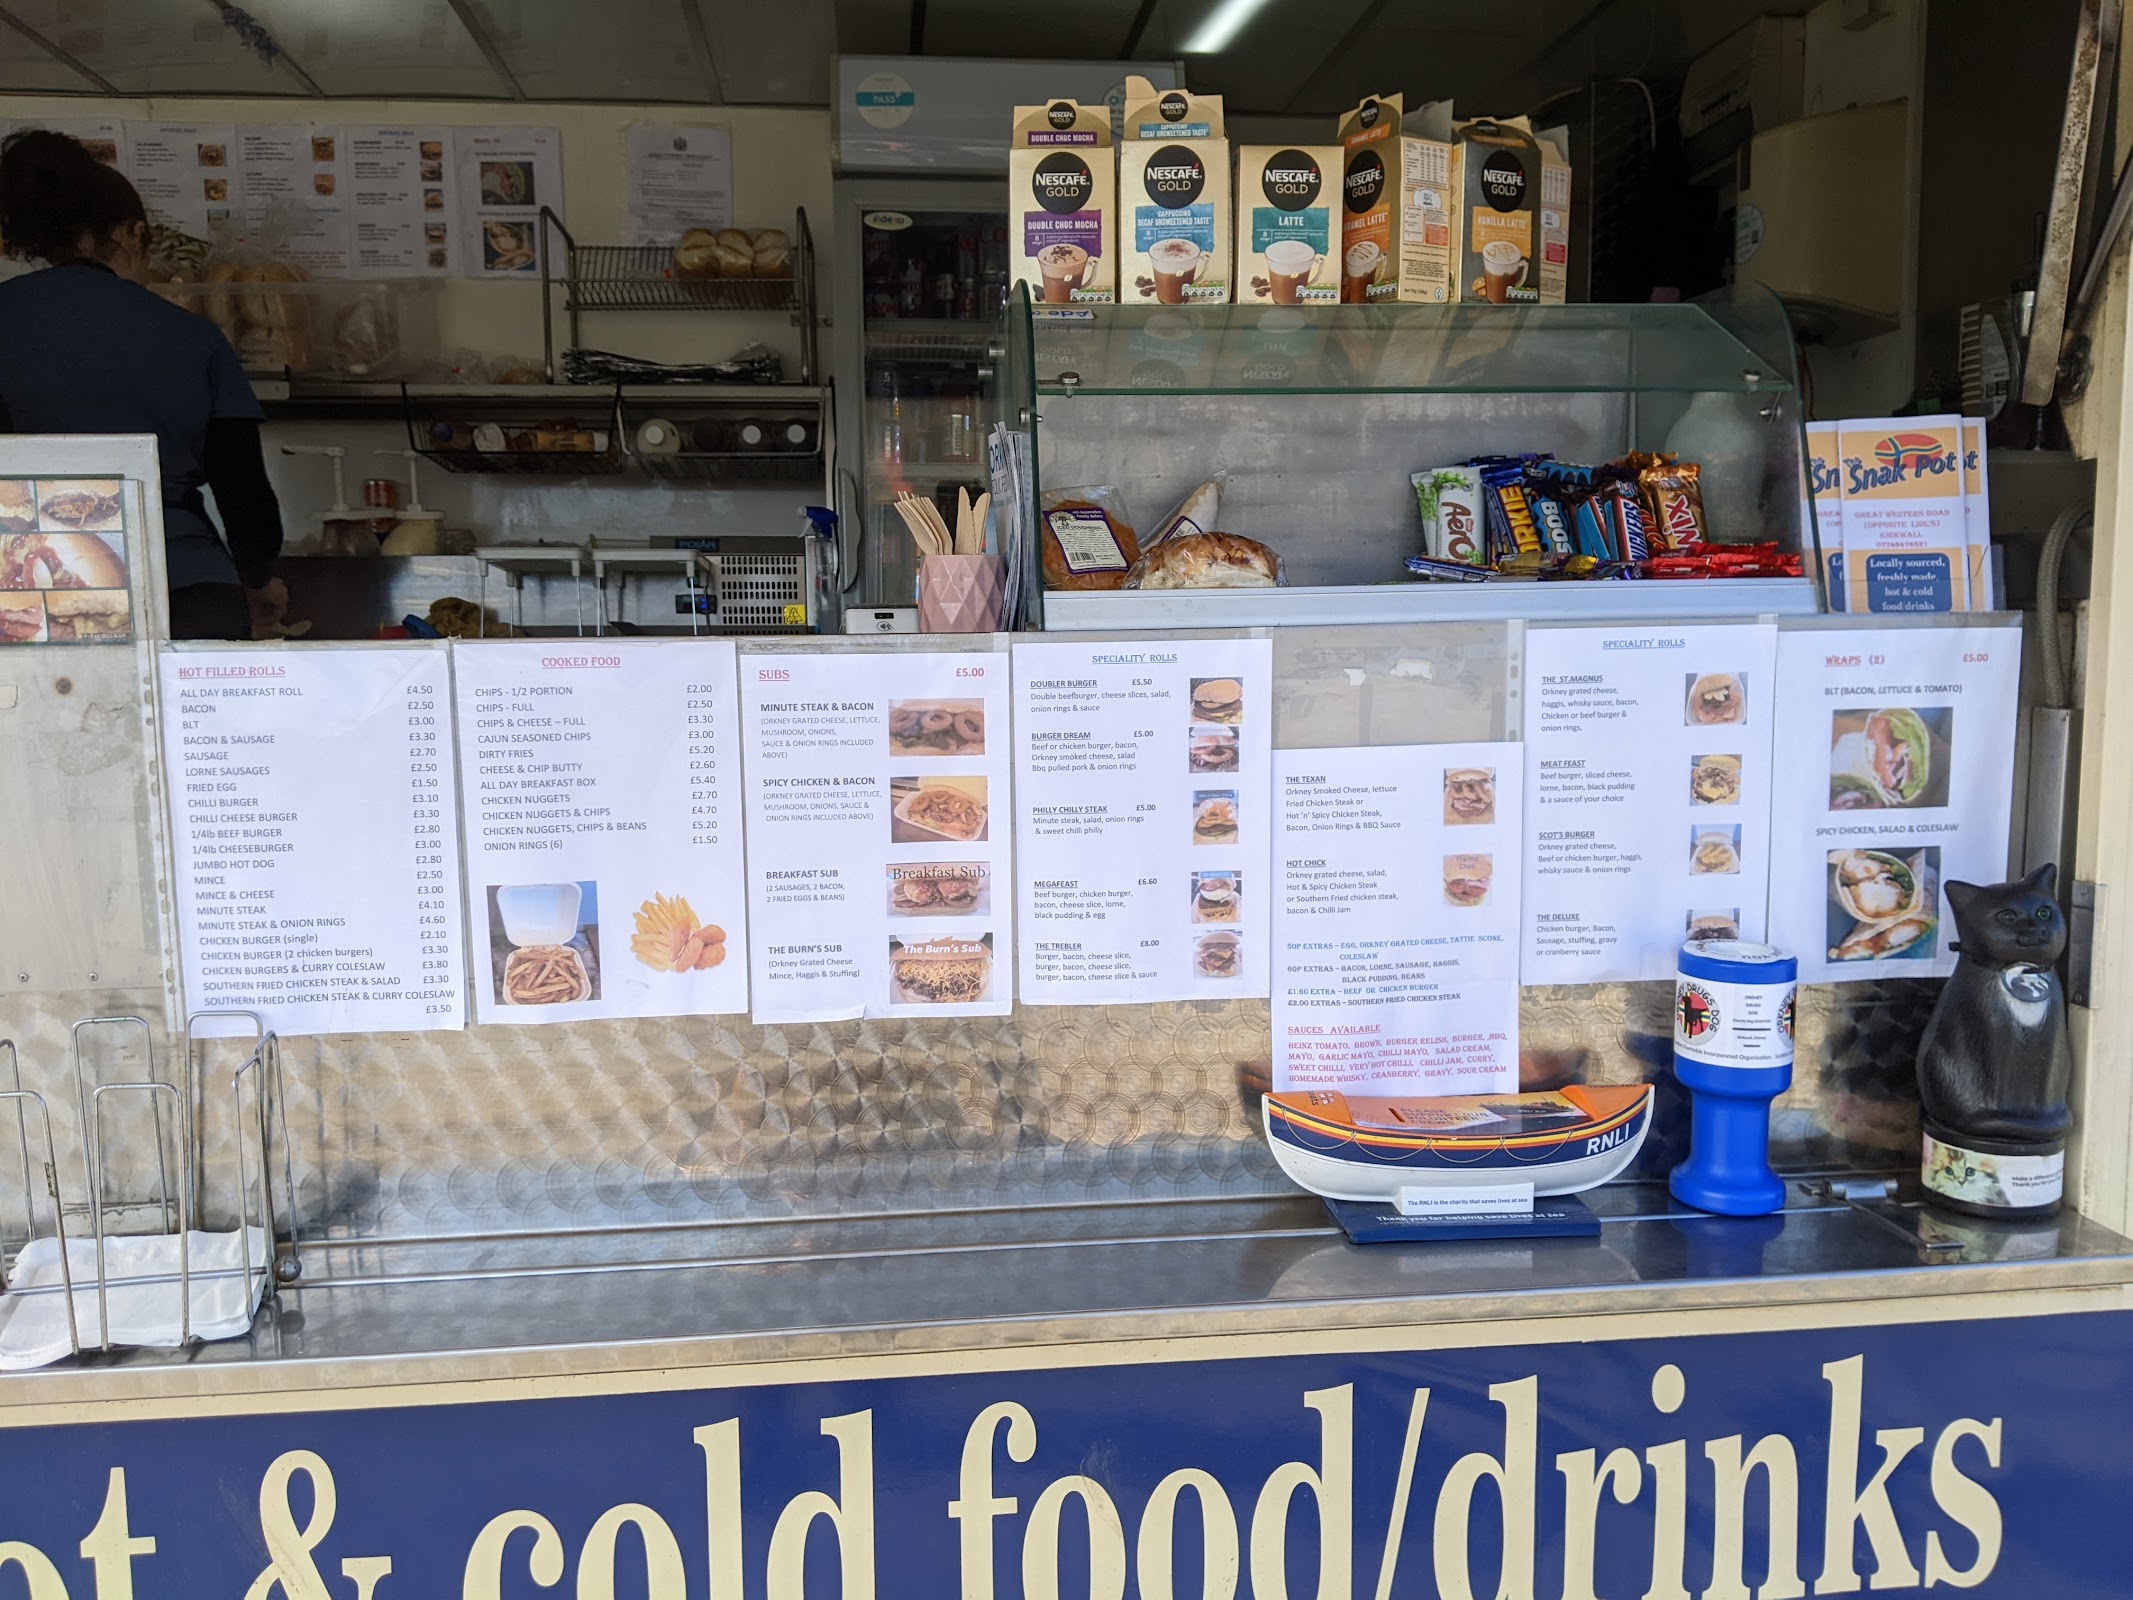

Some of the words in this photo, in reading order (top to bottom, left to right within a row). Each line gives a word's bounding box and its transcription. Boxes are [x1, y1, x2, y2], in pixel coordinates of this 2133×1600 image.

[873, 95, 896, 104] PASS
[1031, 134, 1054, 142] DOUBLE
[1055, 134, 1071, 142] CHOC
[1147, 163, 1203, 180] NESCAFÉ
[1265, 167, 1320, 183] NESCAFÉ
[1346, 164, 1383, 188] NESCAFÉ
[1035, 169, 1091, 186] NESCAFÉ
[1483, 169, 1525, 187] NESCAFÉ
[1045, 186, 1079, 197] GOLD
[1156, 181, 1191, 191] GOLD
[1275, 184, 1308, 194] GOLD
[1351, 184, 1375, 197] GOLD
[1491, 185, 1518, 196] GOLD
[1157, 209, 1191, 217] CAPPUCCINO
[1027, 220, 1053, 230] DOUBLE
[1054, 220, 1073, 229] CHOC
[1074, 220, 1098, 229] MOCHA
[1278, 216, 1304, 226] LATTE
[1344, 219, 1366, 230] ARAMEL
[1476, 215, 1505, 226] VANILLA
[1848, 457, 1906, 495] Snak
[1914, 452, 1957, 478] Pot
[1500, 486, 1541, 553] ORKIE
[1441, 501, 1476, 561] Aero
[1541, 501, 1573, 553] BOOS
[1624, 501, 1648, 561] NICKERS
[1868, 555, 1903, 569] Locally
[1905, 554, 1947, 567] sourced,
[1877, 572, 1908, 584] freshly
[1884, 586, 1900, 596] hot
[1901, 587, 1911, 596] &
[1912, 586, 1933, 596] cold
[1881, 601, 1936, 613] food/drinks
[1603, 640, 1654, 648] SPECIALITY
[1658, 639, 1686, 647] ROLLS
[541, 657, 589, 667] COOKED
[591, 656, 621, 667] FOOD
[1092, 655, 1146, 664] SPECIALITY
[1149, 653, 1178, 663] ROLLS
[1825, 655, 1861, 666] WRAPS
[1868, 654, 1885, 665] (2)
[1962, 653, 1988, 662] £5.00
[179, 667, 203, 678] HOT
[206, 667, 246, 677] FILLED
[249, 666, 286, 676] ROLLS
[758, 669, 790, 681] SUBS
[956, 667, 984, 677] £5.00
[180, 689, 198, 698] ALL
[199, 688, 219, 697] DAY
[222, 687, 276, 697] BREAKFAST
[279, 687, 303, 696] ROLL
[406, 685, 433, 694] £4.50
[1824, 687, 1839, 695] BLT
[1840, 686, 1876, 696] (BACON,
[1878, 685, 1912, 694] LETTUCE
[1914, 685, 1922, 693] &
[1923, 684, 1963, 693] TOMATO)
[476, 703, 504, 712] CHIPS
[511, 703, 534, 711] FULL
[687, 699, 712, 708] £2.50
[760, 703, 798, 711] MINUTE
[800, 703, 829, 711] STEAK
[831, 702, 839, 711] &
[841, 702, 874, 711] BACON
[477, 734, 508, 743] CAJUN
[511, 733, 562, 742] SEASONED
[564, 732, 591, 741] CHIPS
[688, 730, 714, 739] £3.00
[1063, 732, 1091, 740] DREAM
[478, 750, 506, 758] DIRTY
[508, 749, 534, 758] FRIES
[689, 745, 714, 754] £5.20
[1541, 760, 1561, 768] MEAT
[189, 814, 218, 823] CHILLI
[220, 813, 256, 822] CHEESE
[258, 812, 298, 822] BURGER
[413, 809, 439, 818] £3.30
[1304, 859, 1326, 867] CHICK
[892, 867, 956, 880] Breakfast
[960, 866, 986, 879] Sub
[1034, 880, 1078, 889] MEGAFEAST
[419, 915, 445, 924] £4.60
[1552, 913, 1580, 921] DELUXE
[198, 921, 236, 930] MINUTE
[238, 921, 267, 929] STEAK
[269, 920, 278, 929] &
[280, 918, 314, 928] ONION
[316, 917, 345, 926] RINGS
[199, 936, 239, 945] CHICKEN
[242, 935, 281, 945] BURGER
[283, 933, 318, 944] (single)
[420, 930, 446, 939] £2.10
[903, 945, 920, 953] The
[925, 944, 958, 953] Burn's
[961, 944, 982, 952] Sub
[1687, 982, 1715, 1006] DRUGS
[1709, 1009, 1720, 1033] DOG
[1288, 1026, 1324, 1035] SAUCES
[1331, 1024, 1381, 1034] AVAILABLE
[1354, 1039, 1383, 1048] BROWN,
[1703, 1050, 1738, 1060] Incorporated
[1585, 1123, 1631, 1156] RNLI
[244, 1450, 392, 1600] &
[463, 1409, 875, 1600] cold
[949, 1354, 2002, 1600] food/drinks
